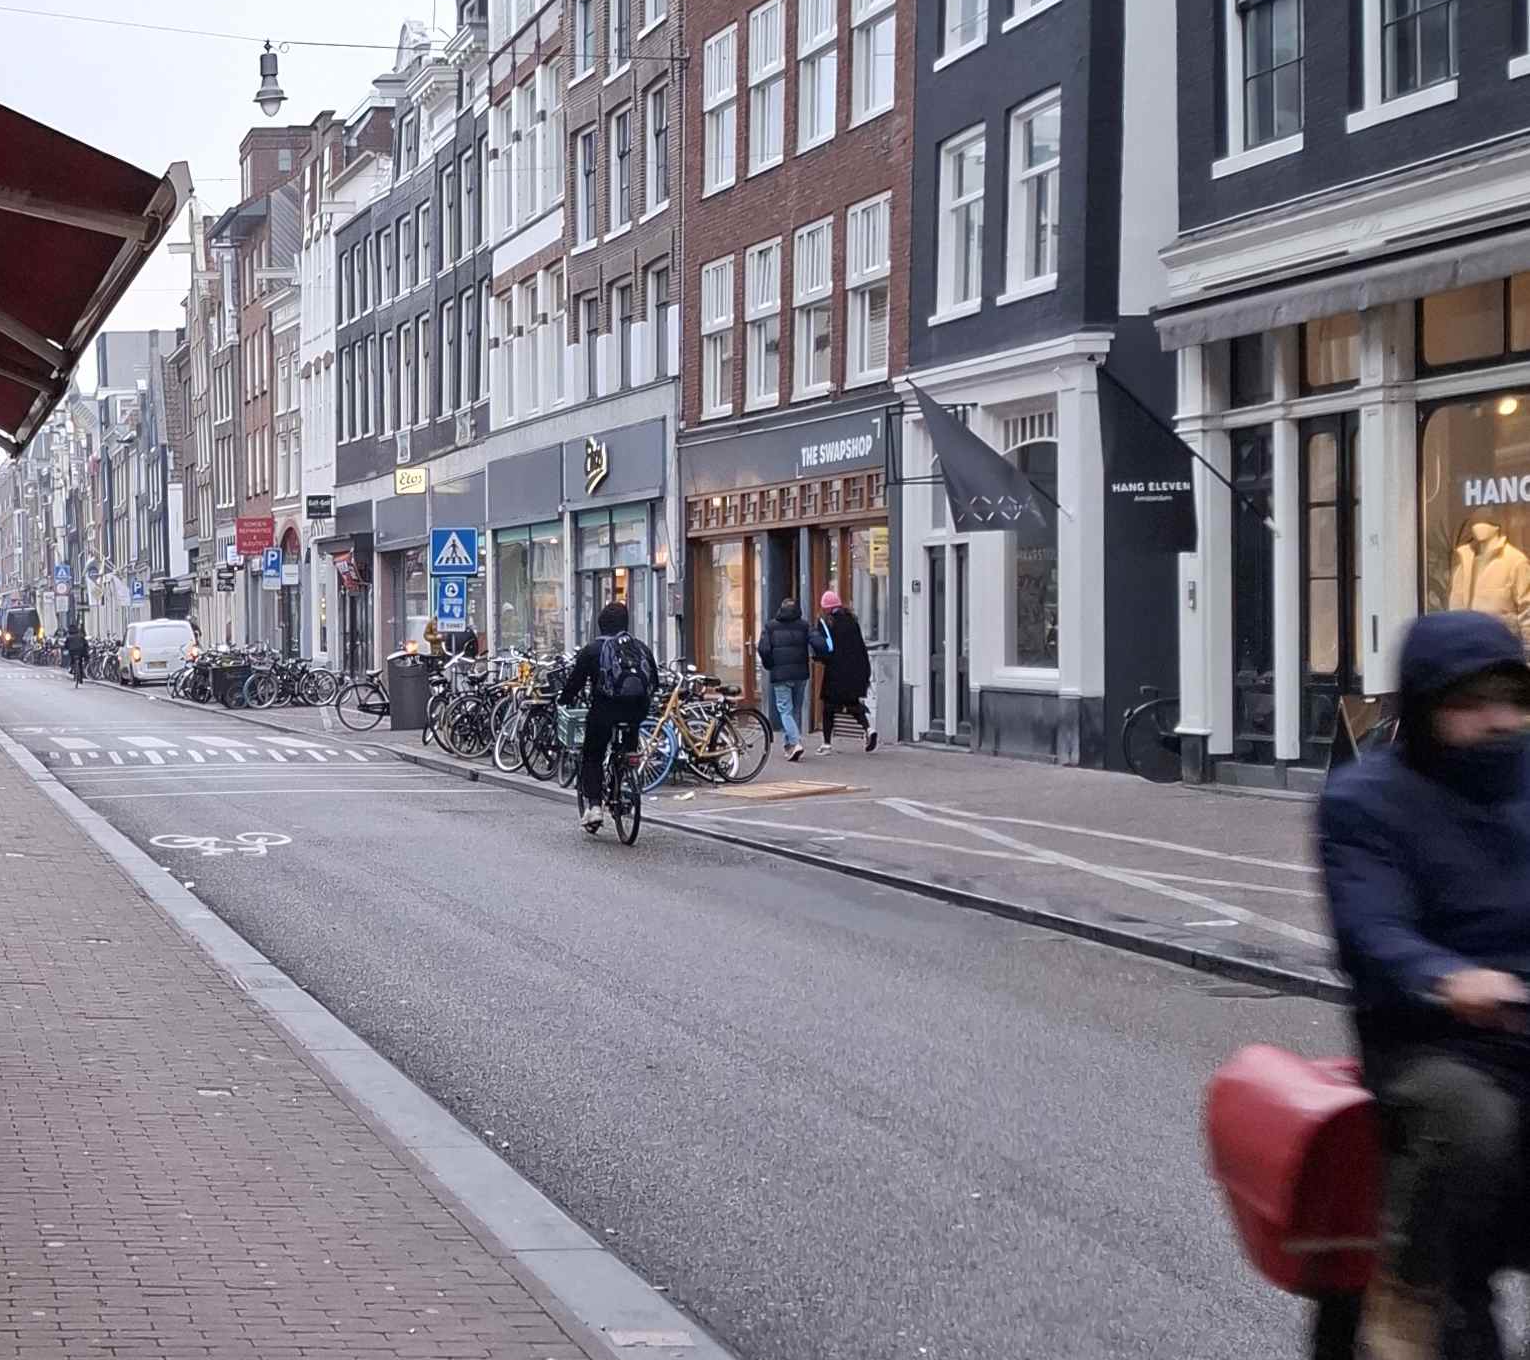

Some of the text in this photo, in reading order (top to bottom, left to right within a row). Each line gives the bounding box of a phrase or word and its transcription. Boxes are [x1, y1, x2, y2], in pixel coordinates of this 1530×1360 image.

[801, 434, 873, 467] THE SWAPSHOP
[1112, 481, 1190, 493] HANG ELEVEN
[268, 551, 278, 567] P
[134, 582, 142, 593] P
